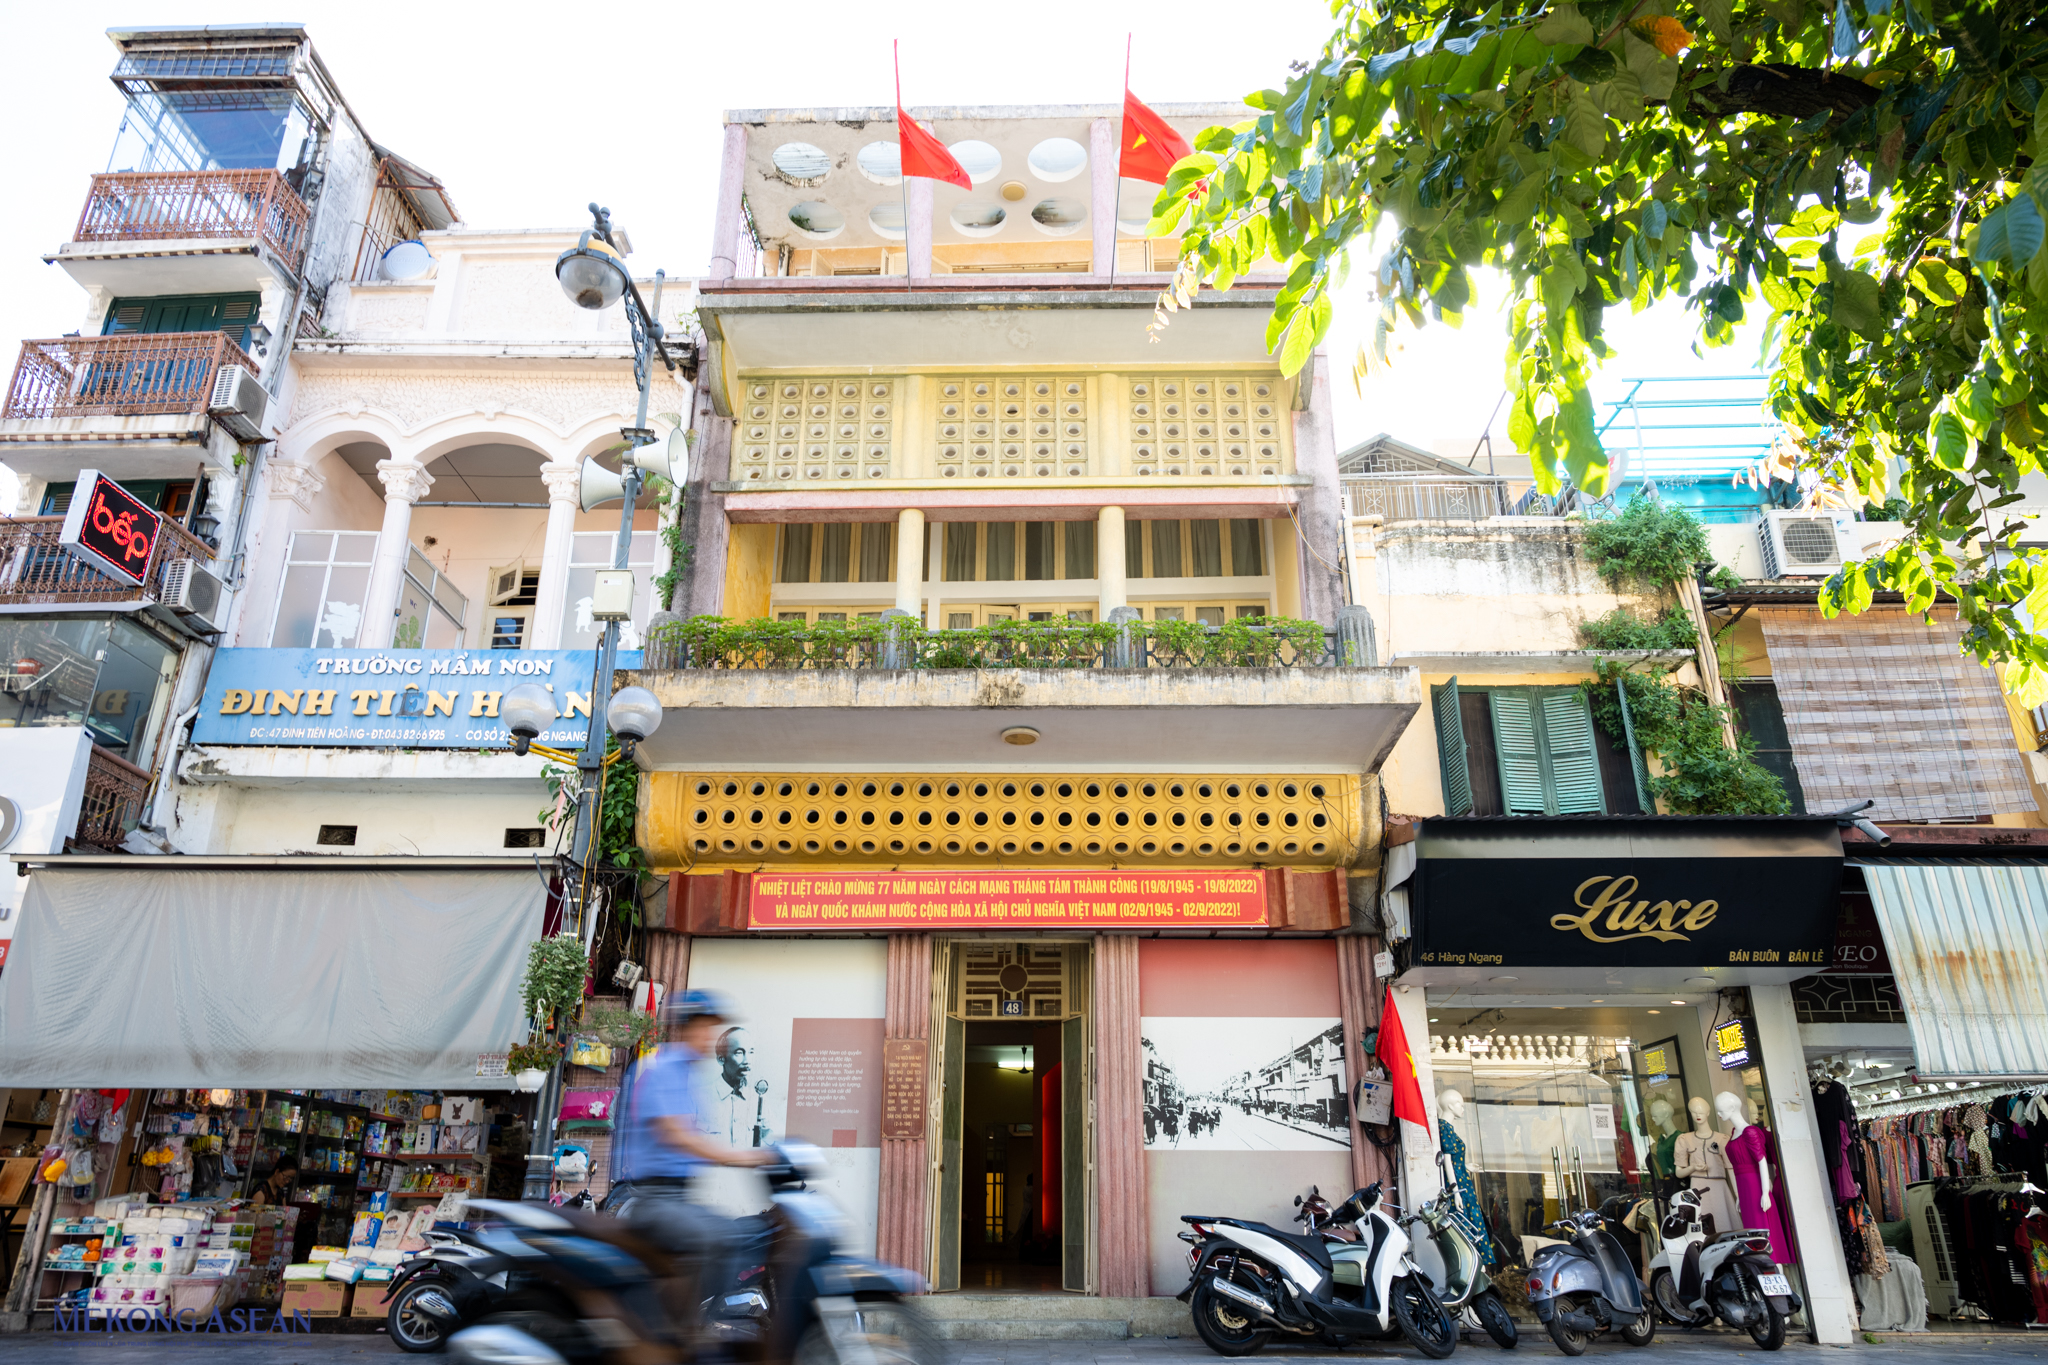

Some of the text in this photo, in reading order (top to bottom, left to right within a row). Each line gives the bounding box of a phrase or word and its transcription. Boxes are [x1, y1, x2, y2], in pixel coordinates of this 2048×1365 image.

[92, 492, 148, 562] bếp
[316, 652, 554, 676] TRƯỜNG MẦM NON
[219, 689, 338, 716] ĐINH
[350, 682, 459, 718] TIÊN
[282, 728, 305, 738] ĐINH
[307, 726, 326, 738] TIÊN
[328, 726, 365, 739] HOÀNG
[466, 730, 482, 741] CƠ
[484, 727, 498, 741] SỞ
[551, 731, 588, 742] NGANG
[759, 879, 788, 898] NHIỆT
[791, 879, 812, 898] LIỆT
[814, 879, 842, 895] CHÀO
[844, 879, 875, 895] MỪNG
[878, 881, 890, 894] 77
[892, 878, 916, 894] NĂM
[919, 878, 946, 894] NGÀY
[949, 878, 976, 894] CÁCH
[979, 880, 1010, 897] MẠNG
[1013, 878, 1046, 894] THÁNG
[1049, 878, 1070, 894] TÁM
[1073, 878, 1107, 894] THÀNH
[1110, 878, 1137, 894] CÔNG
[1140, 880, 1194, 895] (19/8/1945
[1204, 880, 1257, 894] 19/8/2022)
[776, 902, 788, 918] VÀ
[791, 902, 818, 918] NGÀY
[821, 900, 848, 919] QUỐC
[851, 902, 886, 918] KHÁNH
[889, 902, 917, 918] NƯỚC
[920, 902, 948, 920] CỘNG
[950, 901, 971, 917] HÒA
[974, 900, 988, 917] XÃ
[990, 901, 1008, 920] HỘI
[1010, 899, 1031, 917] CHỦ
[1034, 900, 1066, 916] NGHĨA
[1068, 900, 1090, 919] VIỆT
[1092, 903, 1116, 916] NAM
[1120, 903, 1173, 918] (02/9/1945
[1183, 903, 1241, 918] 02/9/2022)!
[1550, 875, 1719, 943] Luxe
[1420, 952, 1503, 964] 46 Hàng Ngang
[1729, 949, 1780, 962] BÁN BUÔN
[1788, 949, 1824, 962] BÁN LẺ
[1833, 946, 1877, 962] EO
[1006, 1003, 1019, 1014] 48
